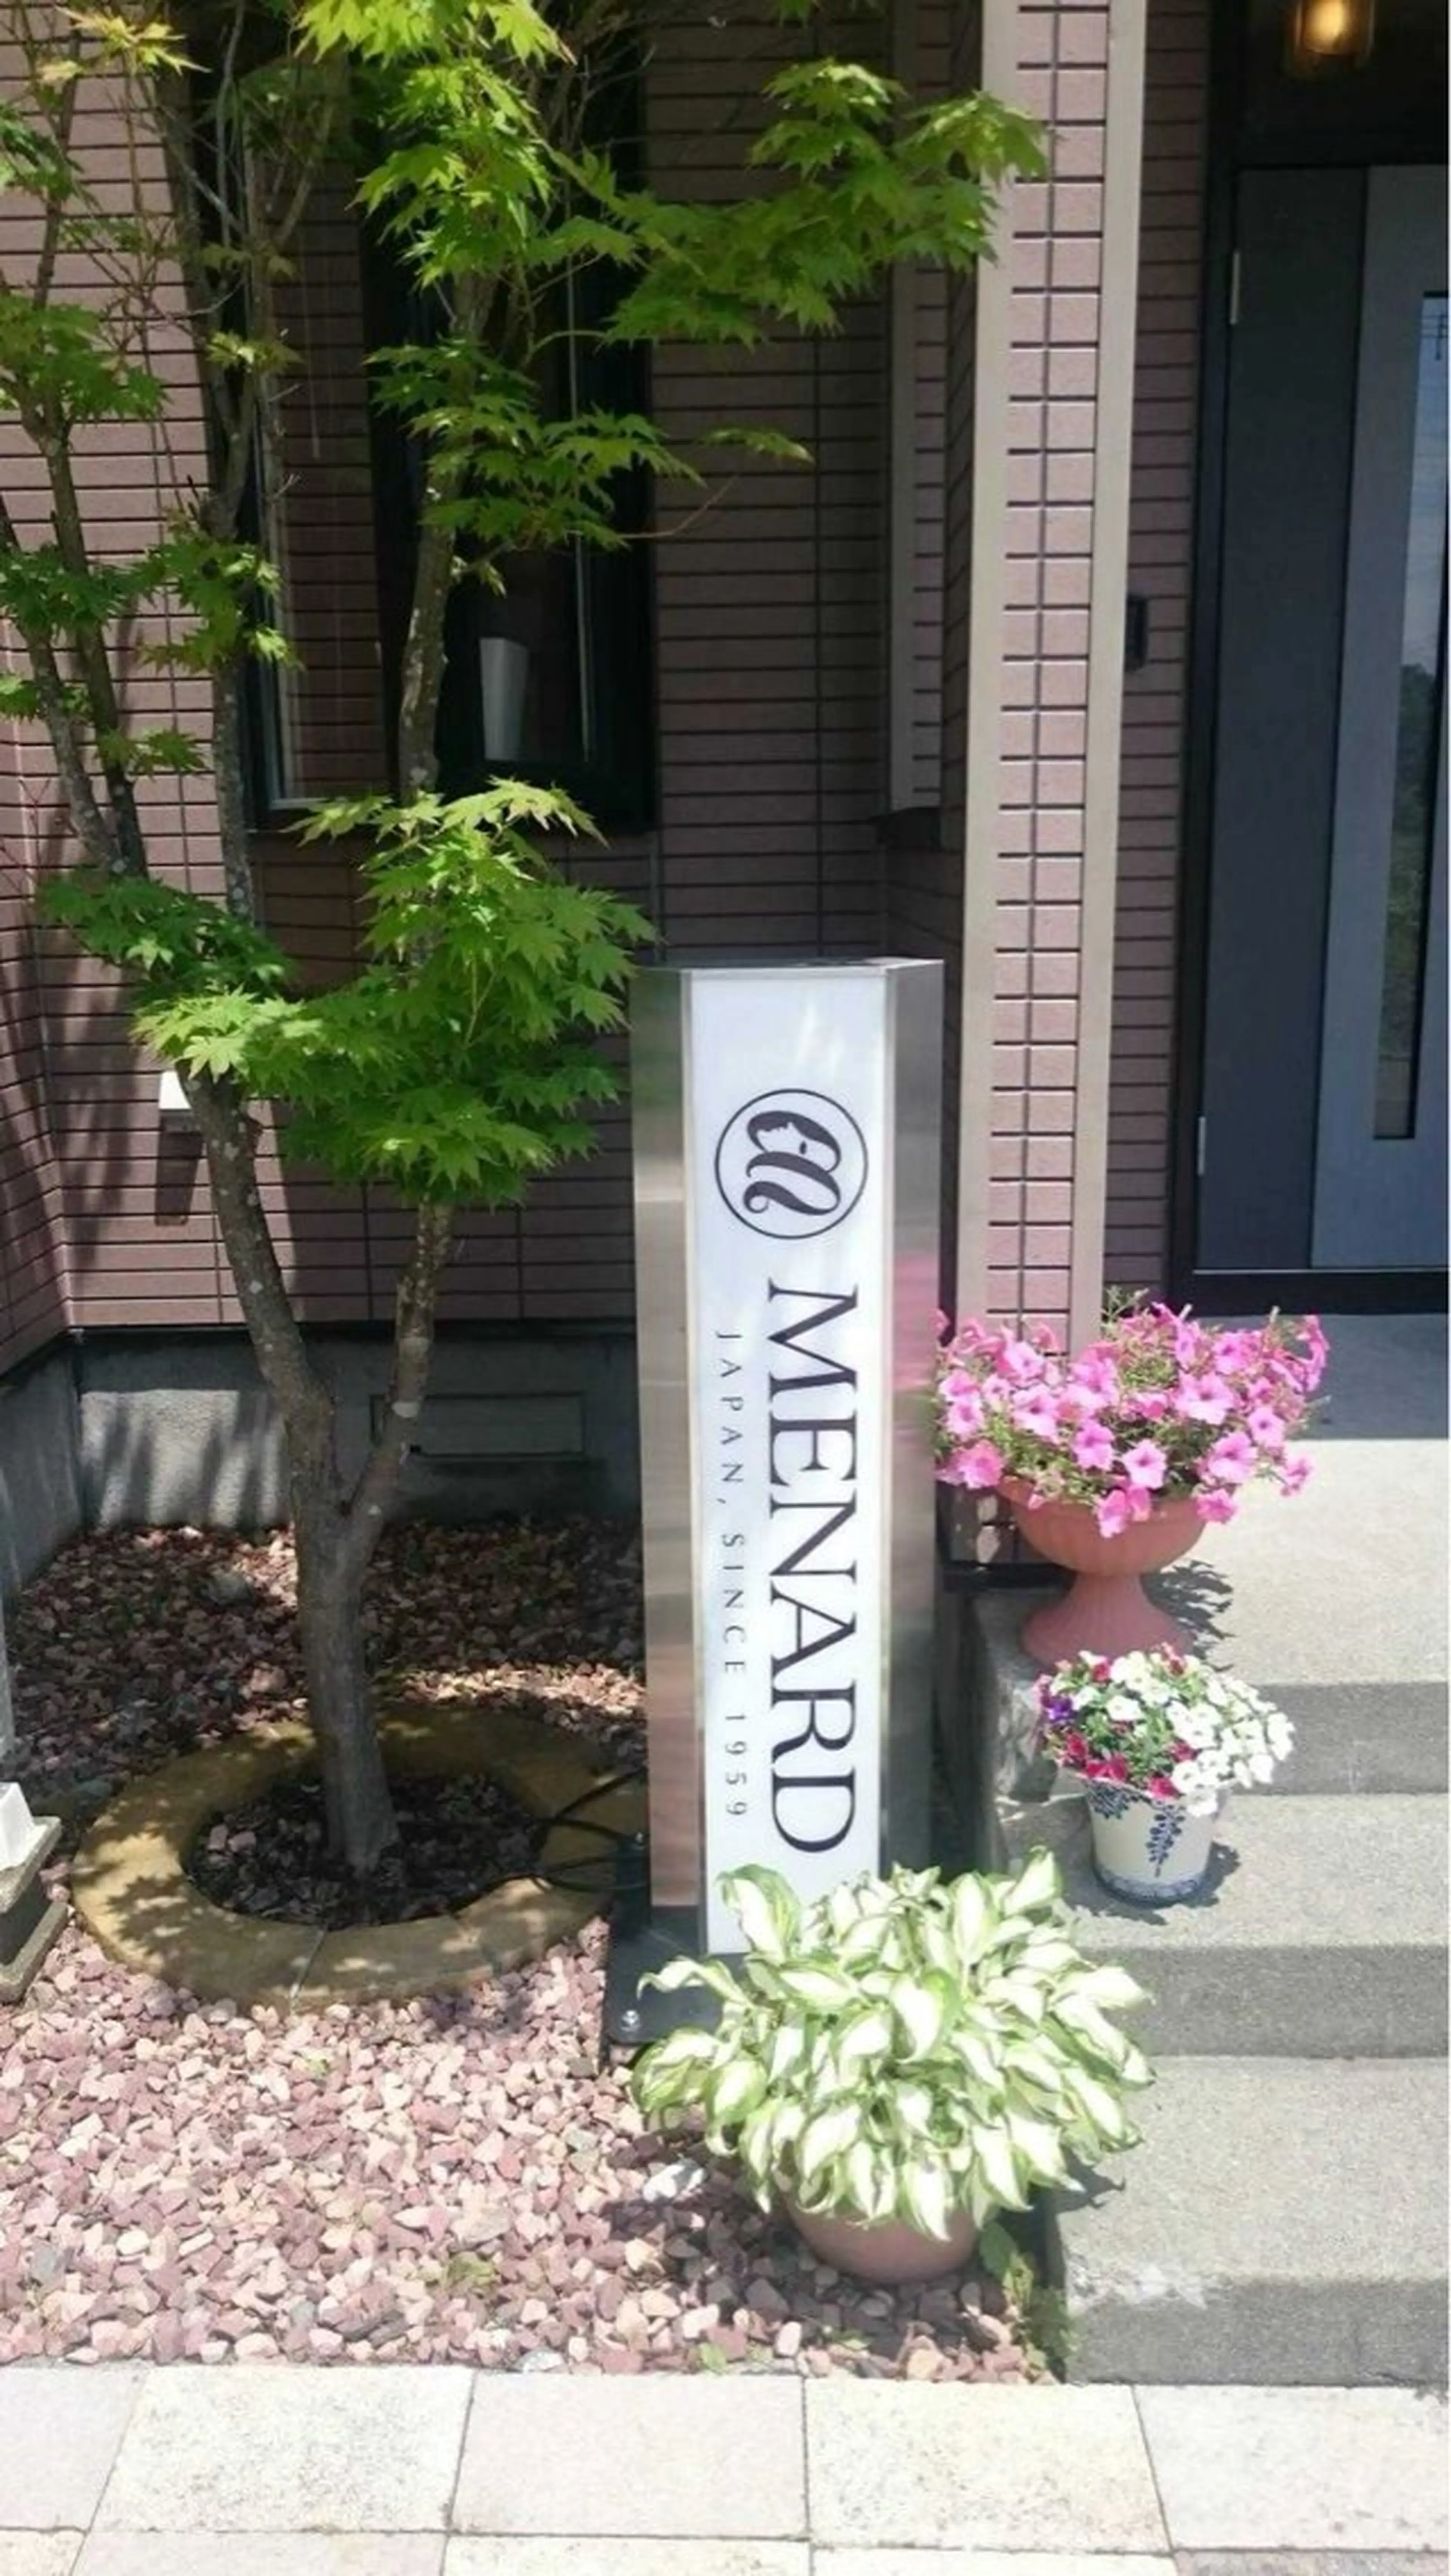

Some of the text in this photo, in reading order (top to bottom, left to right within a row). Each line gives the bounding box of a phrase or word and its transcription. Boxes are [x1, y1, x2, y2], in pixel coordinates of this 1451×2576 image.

[716, 1331, 747, 1816] JAPAN, SINCE 1959
[767, 1277, 859, 1853] MENARD
